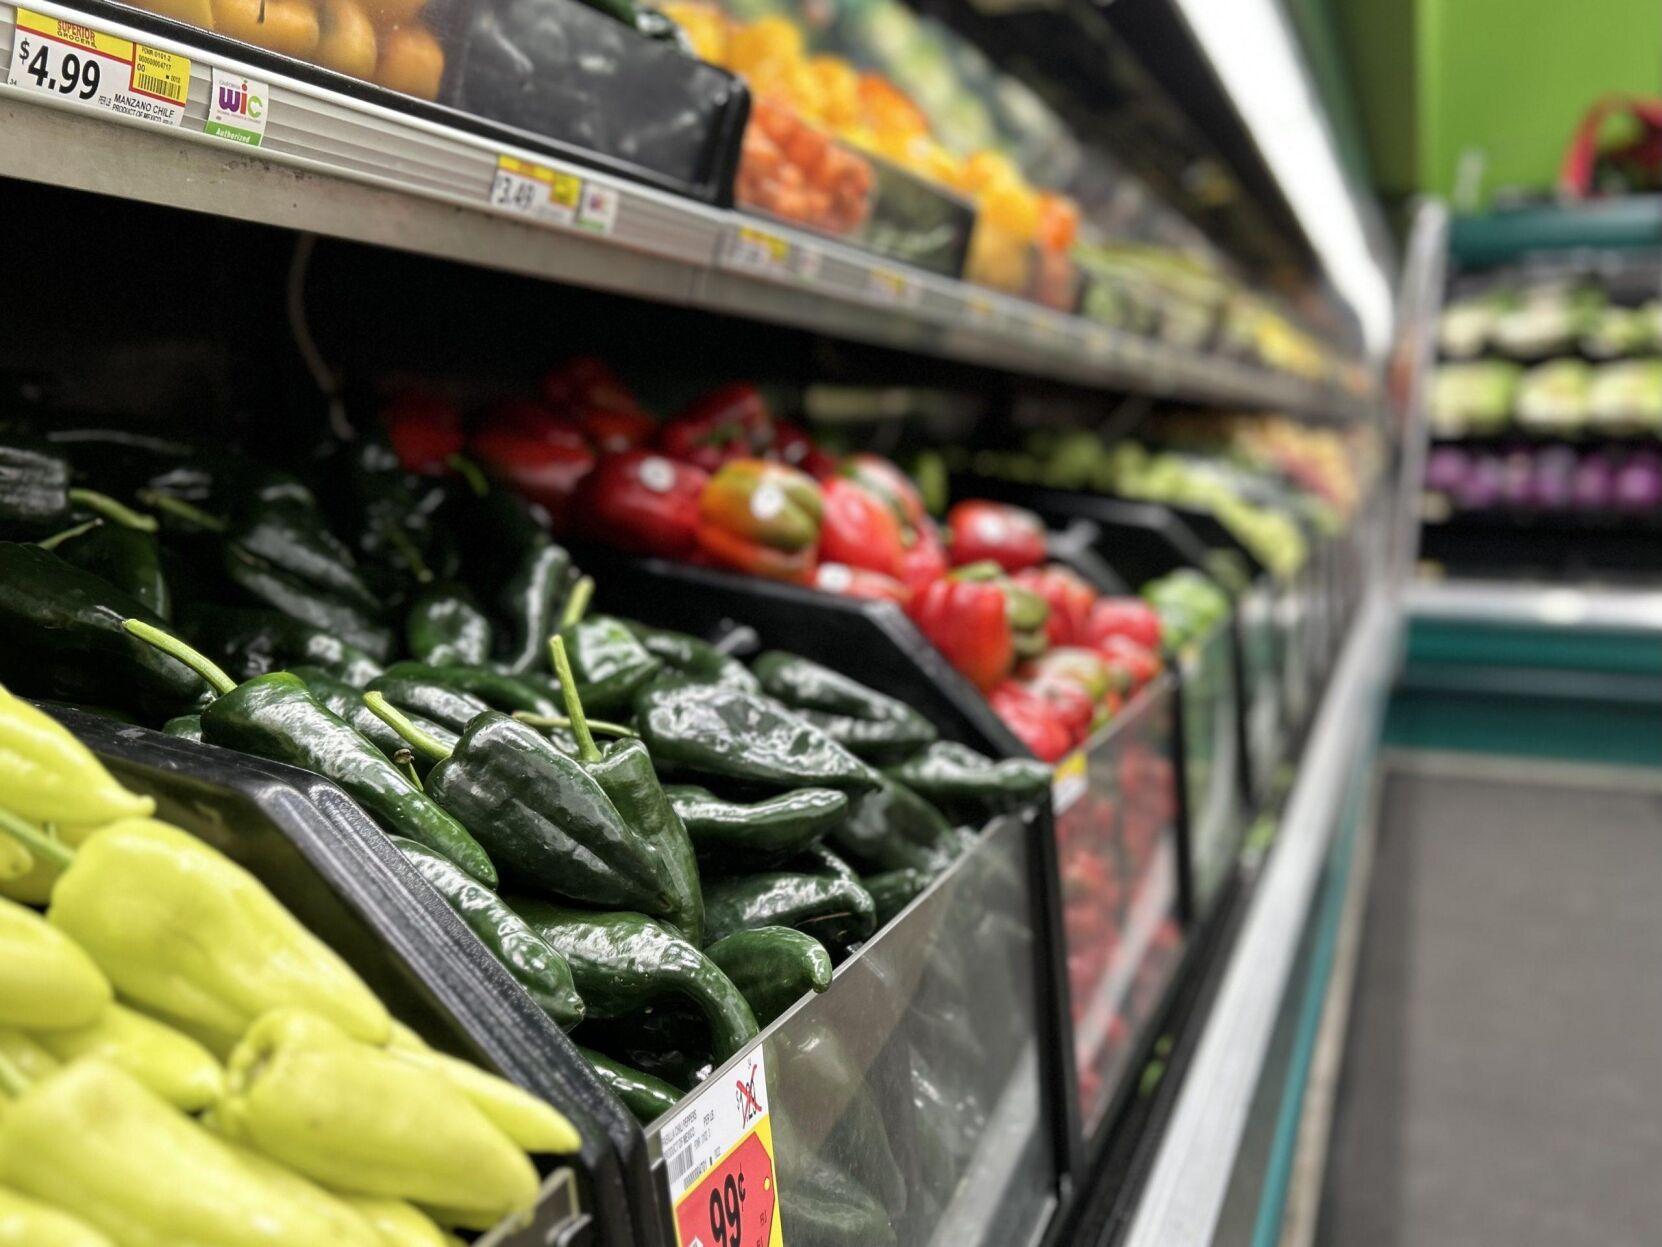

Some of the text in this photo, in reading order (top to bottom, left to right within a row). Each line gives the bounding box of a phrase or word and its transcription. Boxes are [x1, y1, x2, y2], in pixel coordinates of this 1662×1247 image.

[57, 20, 96, 41] SUPERIOR
[18, 37, 101, 99] $4.99
[111, 103, 136, 116] PRODUCT
[114, 93, 152, 112] MANZANO
[215, 127, 251, 143] Authorized
